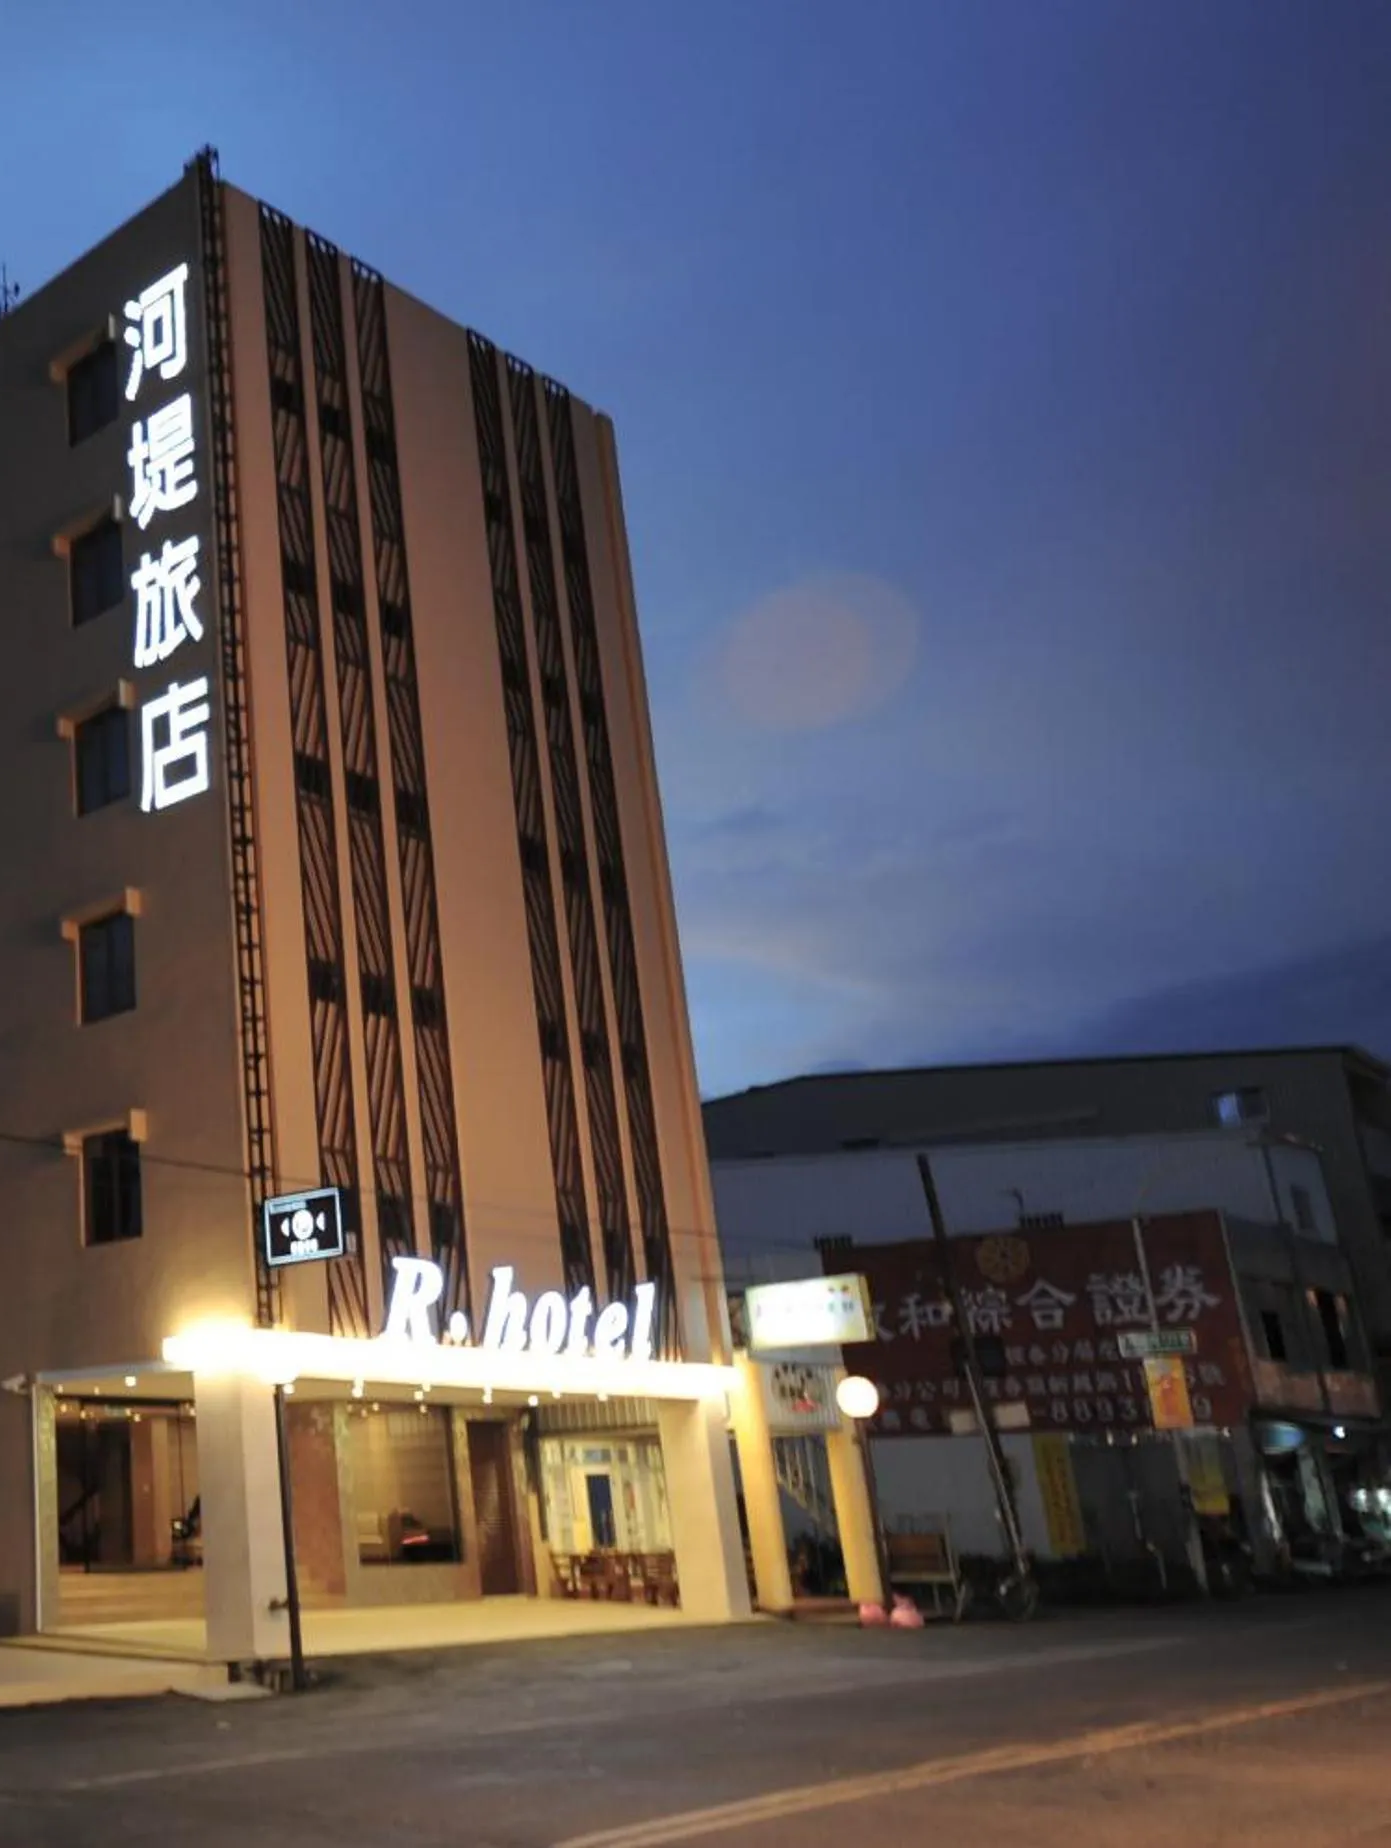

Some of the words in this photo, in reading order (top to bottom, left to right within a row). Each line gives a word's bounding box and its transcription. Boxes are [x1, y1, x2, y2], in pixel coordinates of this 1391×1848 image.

[124, 262, 210, 813] 河堤旅店
[483, 1265, 656, 1361] hotel
